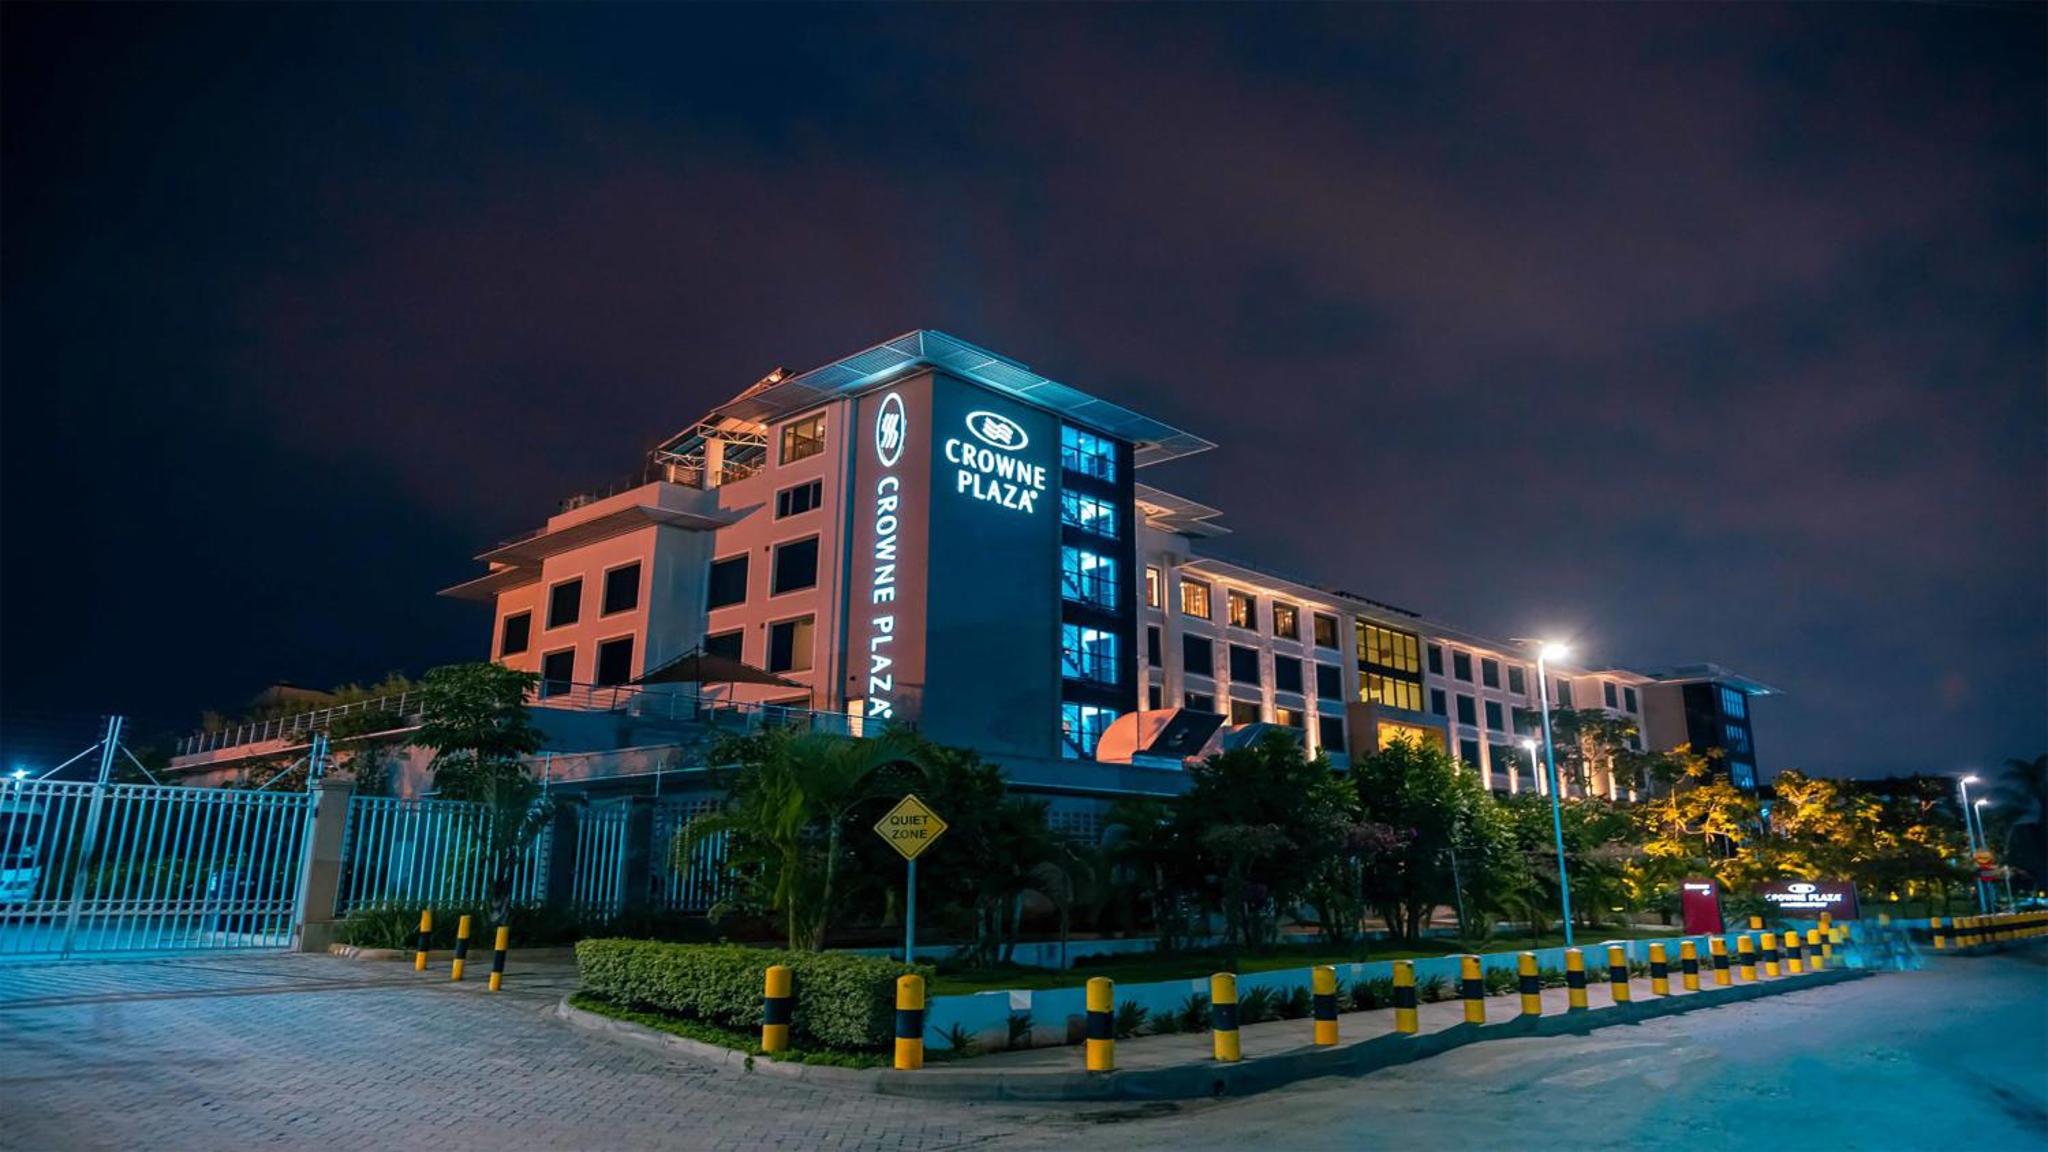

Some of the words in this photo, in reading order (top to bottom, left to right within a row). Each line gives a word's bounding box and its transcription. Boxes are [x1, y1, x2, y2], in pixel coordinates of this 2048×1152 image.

[945, 438, 1046, 491] CROWNE
[957, 470, 1039, 514] PLAZA
[874, 477, 900, 605] CROWNE
[869, 616, 894, 719] PLAZA
[891, 815, 929, 826] QUIET
[892, 829, 928, 839] ZONE
